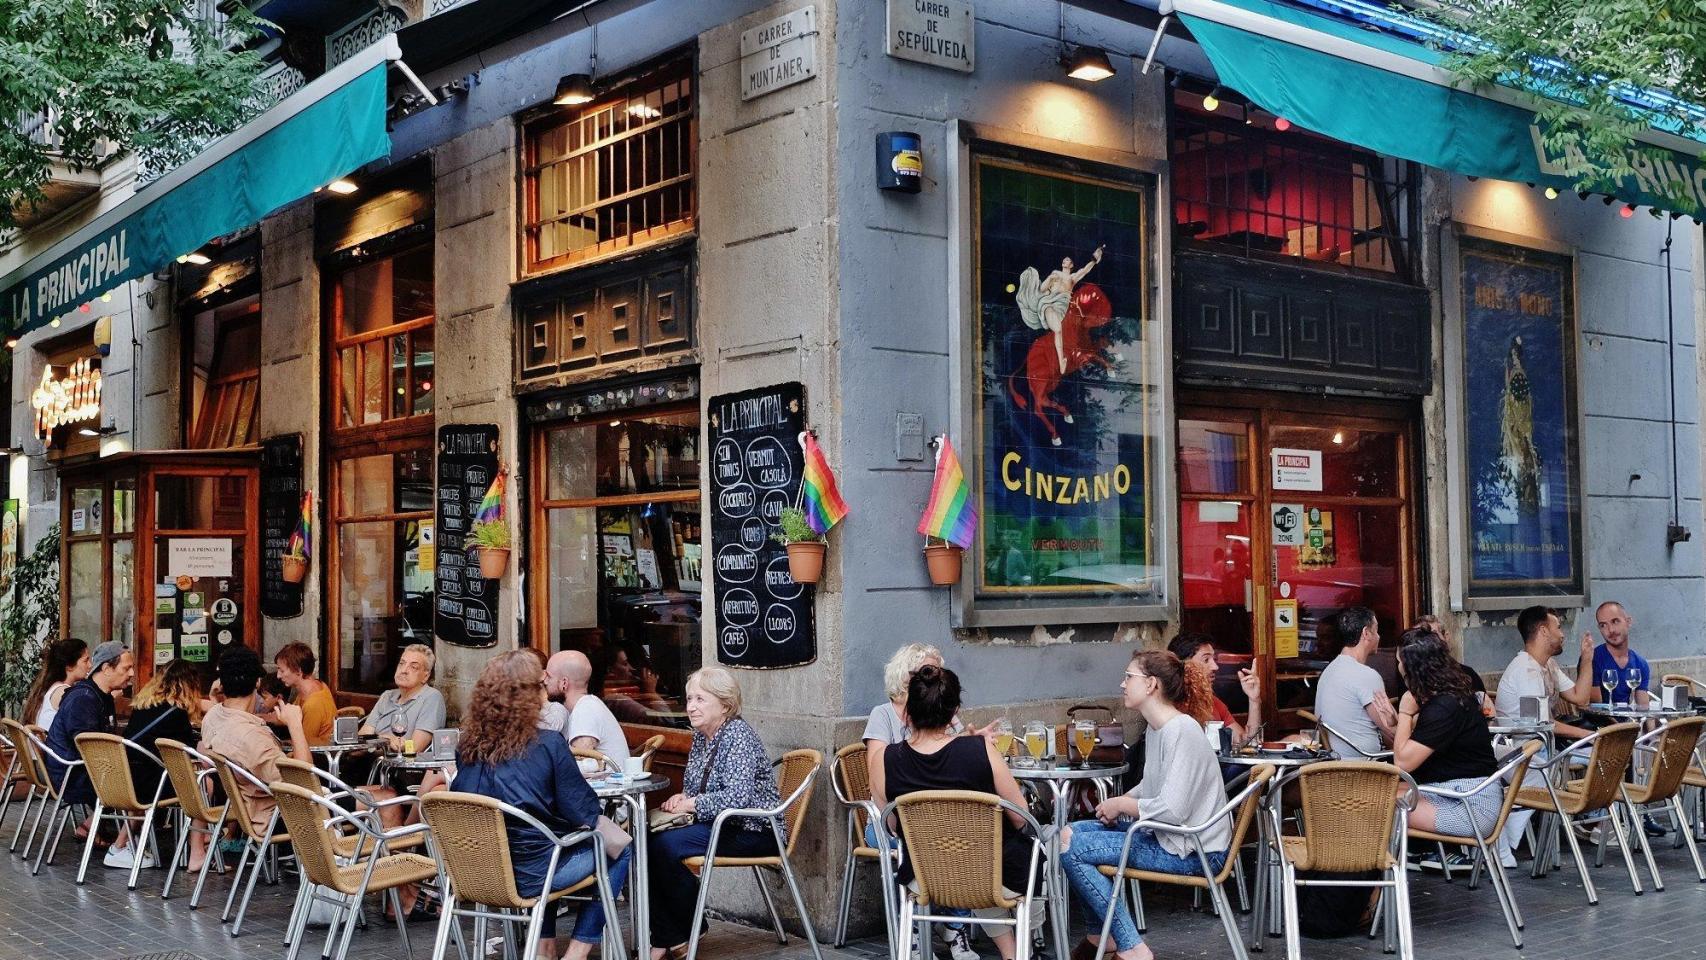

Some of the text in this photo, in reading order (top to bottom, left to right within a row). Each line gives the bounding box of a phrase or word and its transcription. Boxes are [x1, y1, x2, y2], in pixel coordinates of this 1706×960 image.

[915, 0, 950, 19] CARRER
[758, 20, 793, 44] CARRER
[926, 21, 938, 33] DE
[897, 29, 968, 60] SEPÚLVEDA
[770, 45, 781, 61] DE
[750, 56, 803, 91] MUNTANER
[12, 229, 130, 330] LA PRINCIPAL
[722, 394, 787, 433] LA PRINCIPAL
[748, 448, 775, 467] VERMUT
[1278, 456, 1309, 467] LA PRINCIPAL
[719, 462, 740, 478] TONICS
[760, 464, 787, 483] CASOLÀ
[1002, 451, 1131, 505] CINZANO
[743, 527, 761, 542] VINS
[1279, 534, 1293, 543] ZONE
[1032, 539, 1104, 551] VERMOUTH
[720, 554, 755, 570] COMBINATS
[767, 571, 794, 585] REFRES
[768, 617, 792, 631] LICORS
